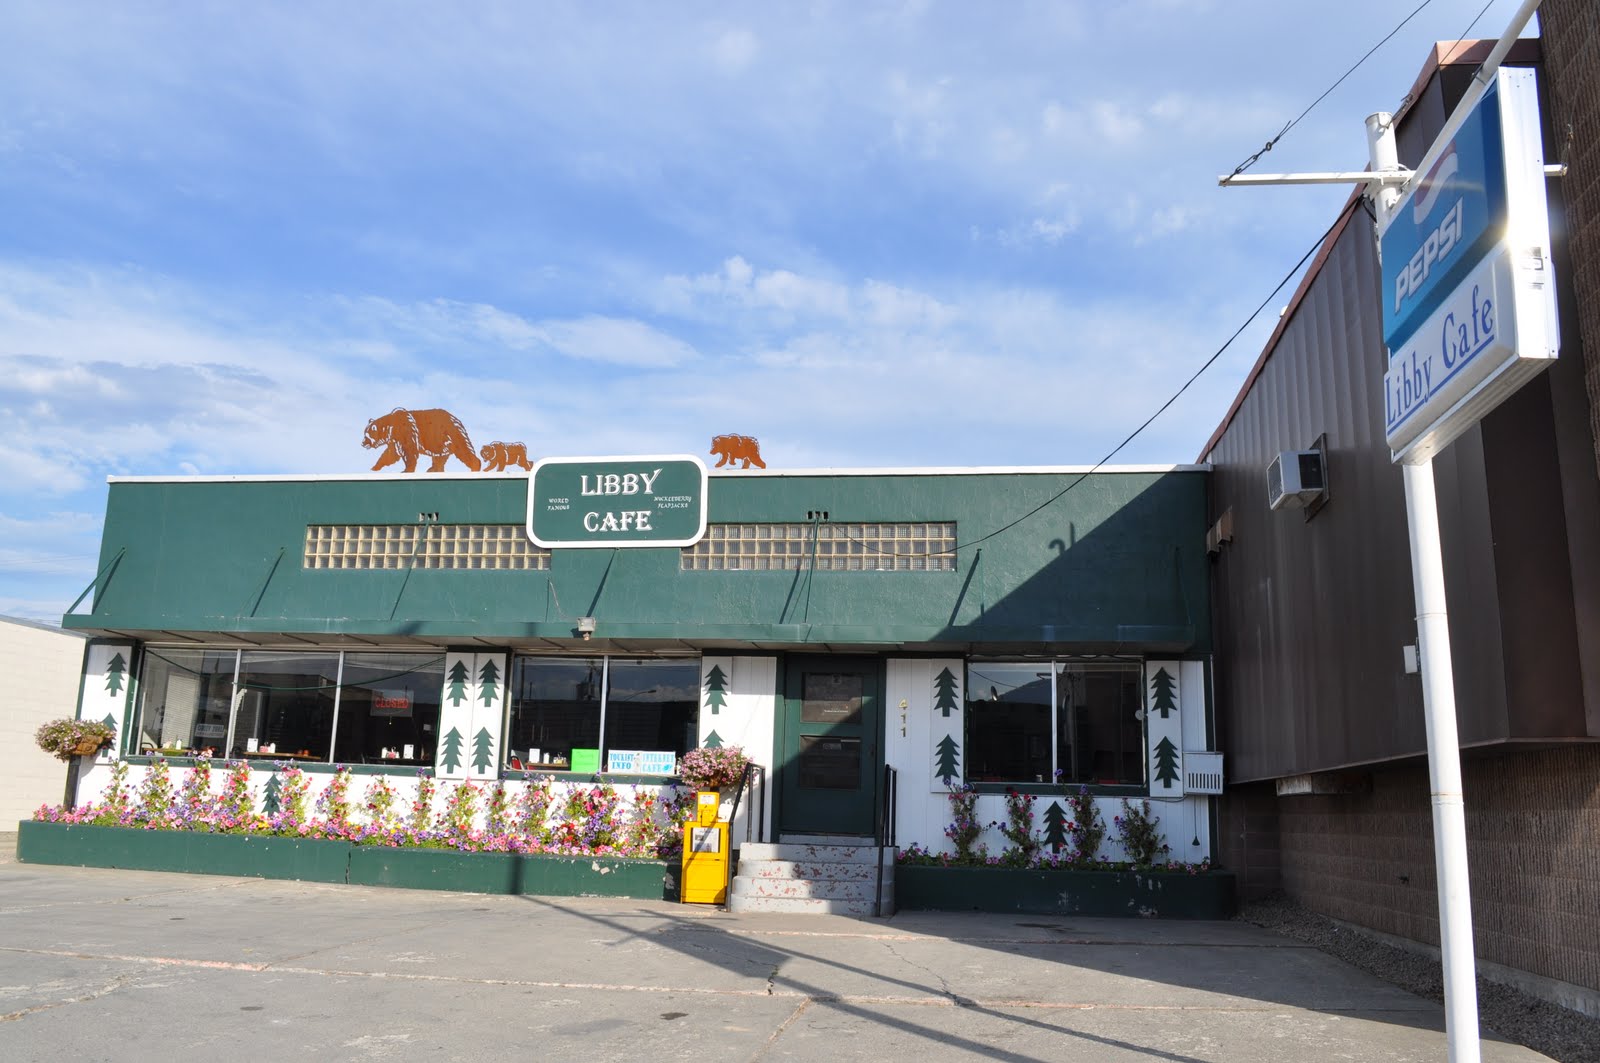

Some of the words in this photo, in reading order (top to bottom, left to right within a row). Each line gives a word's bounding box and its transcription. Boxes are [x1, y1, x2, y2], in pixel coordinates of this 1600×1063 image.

[1395, 196, 1463, 313] PEPSI
[1385, 351, 1431, 427] Libby
[1442, 284, 1493, 369] Cafe
[581, 468, 663, 496] LIBBY
[584, 511, 652, 532] CAFE
[375, 697, 409, 709] CLOSED
[898, 698, 908, 738] 411
[610, 753, 634, 761] TOURIST
[643, 754, 674, 762] INTERNET
[643, 764, 661, 772] CAFE
